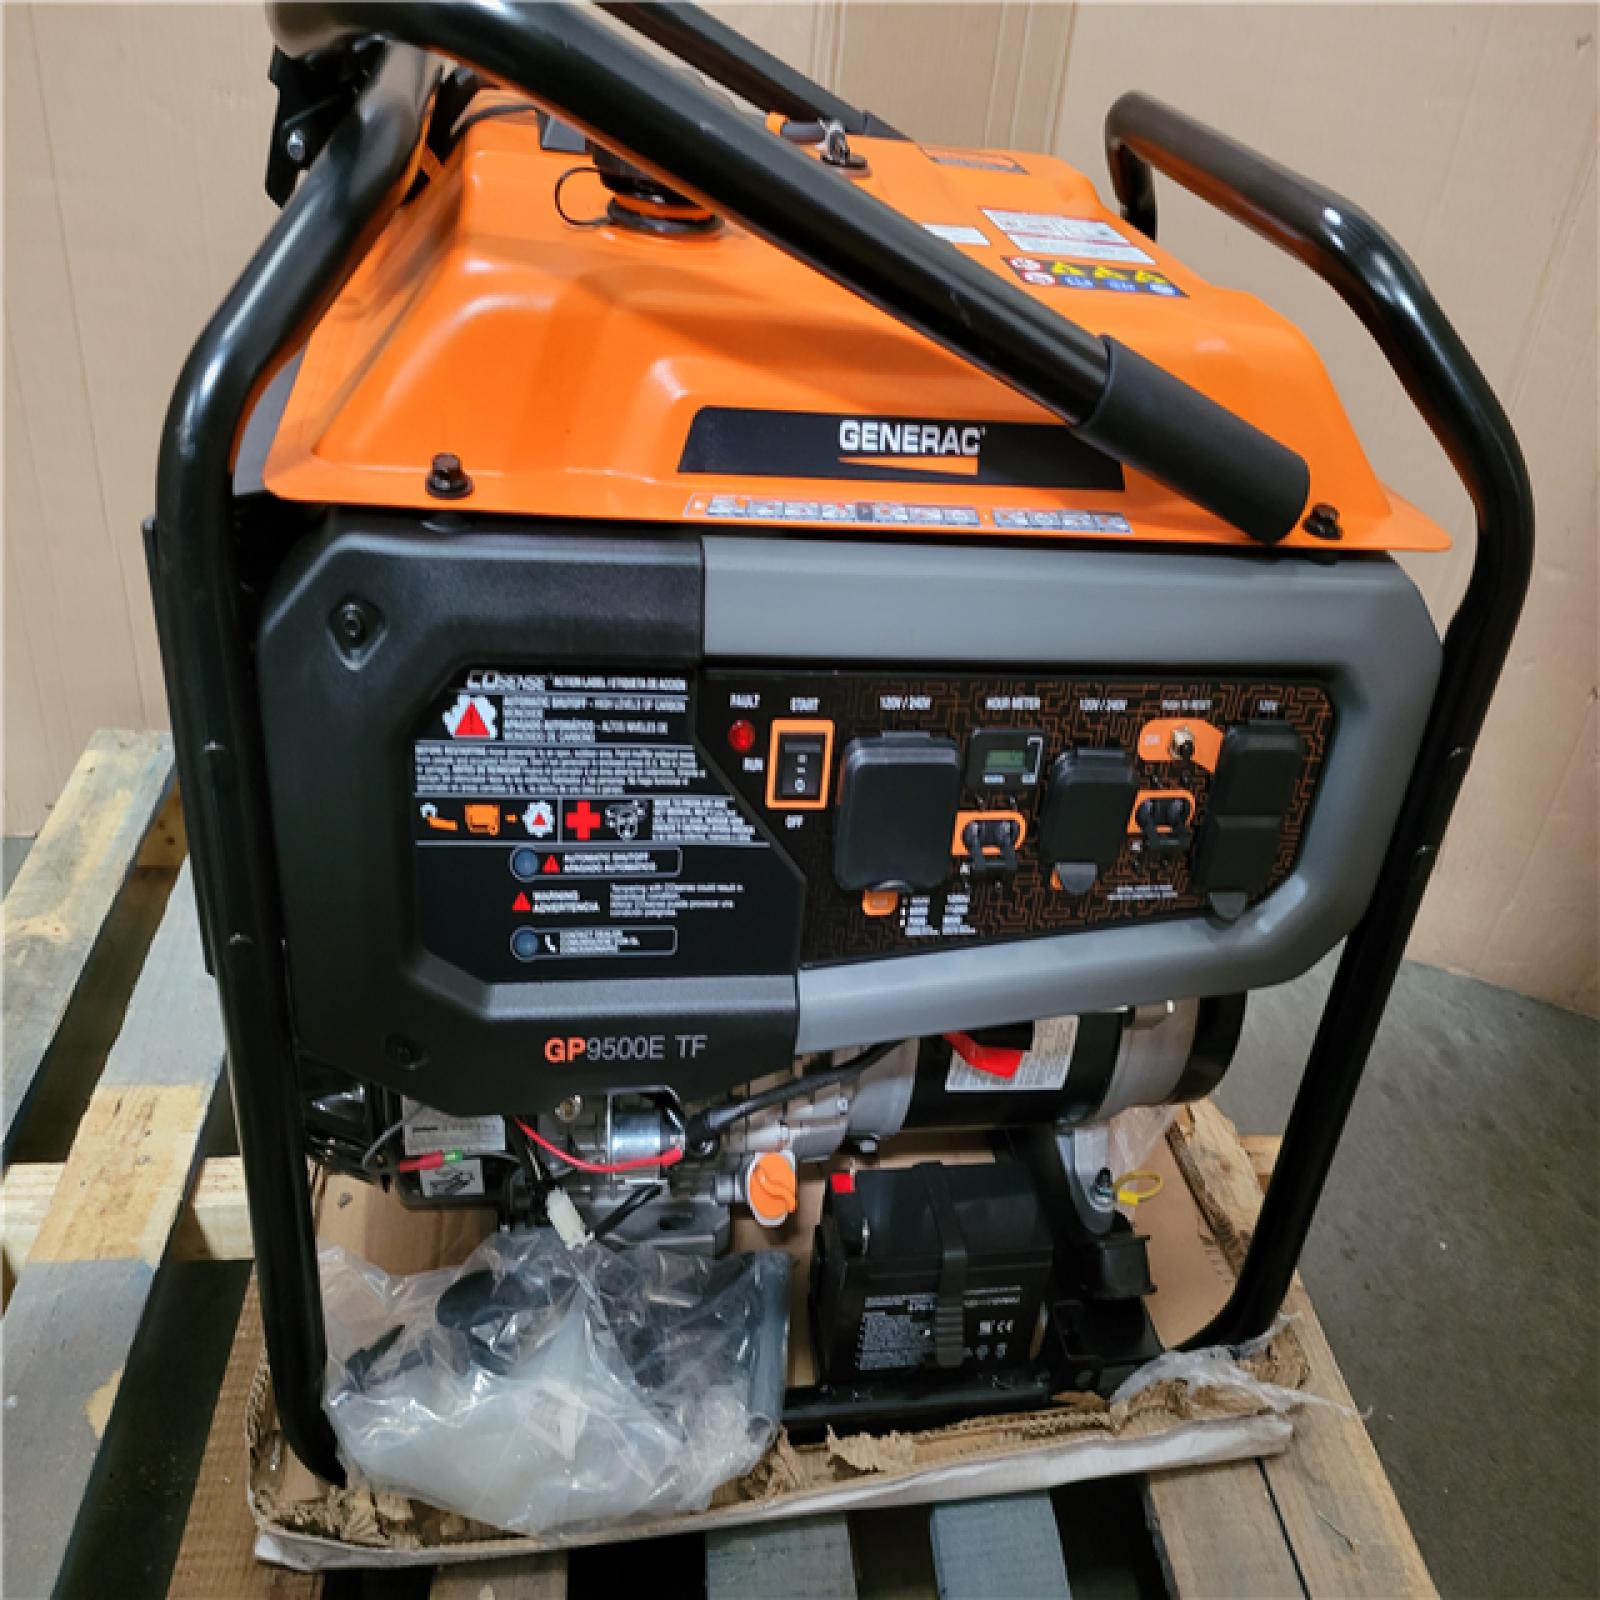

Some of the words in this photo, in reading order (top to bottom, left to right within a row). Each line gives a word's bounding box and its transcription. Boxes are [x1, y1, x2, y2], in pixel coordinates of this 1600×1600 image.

[838, 420, 980, 455] GENERAC
[544, 1035, 666, 1063] GP9500E
[674, 1034, 708, 1059] TF
